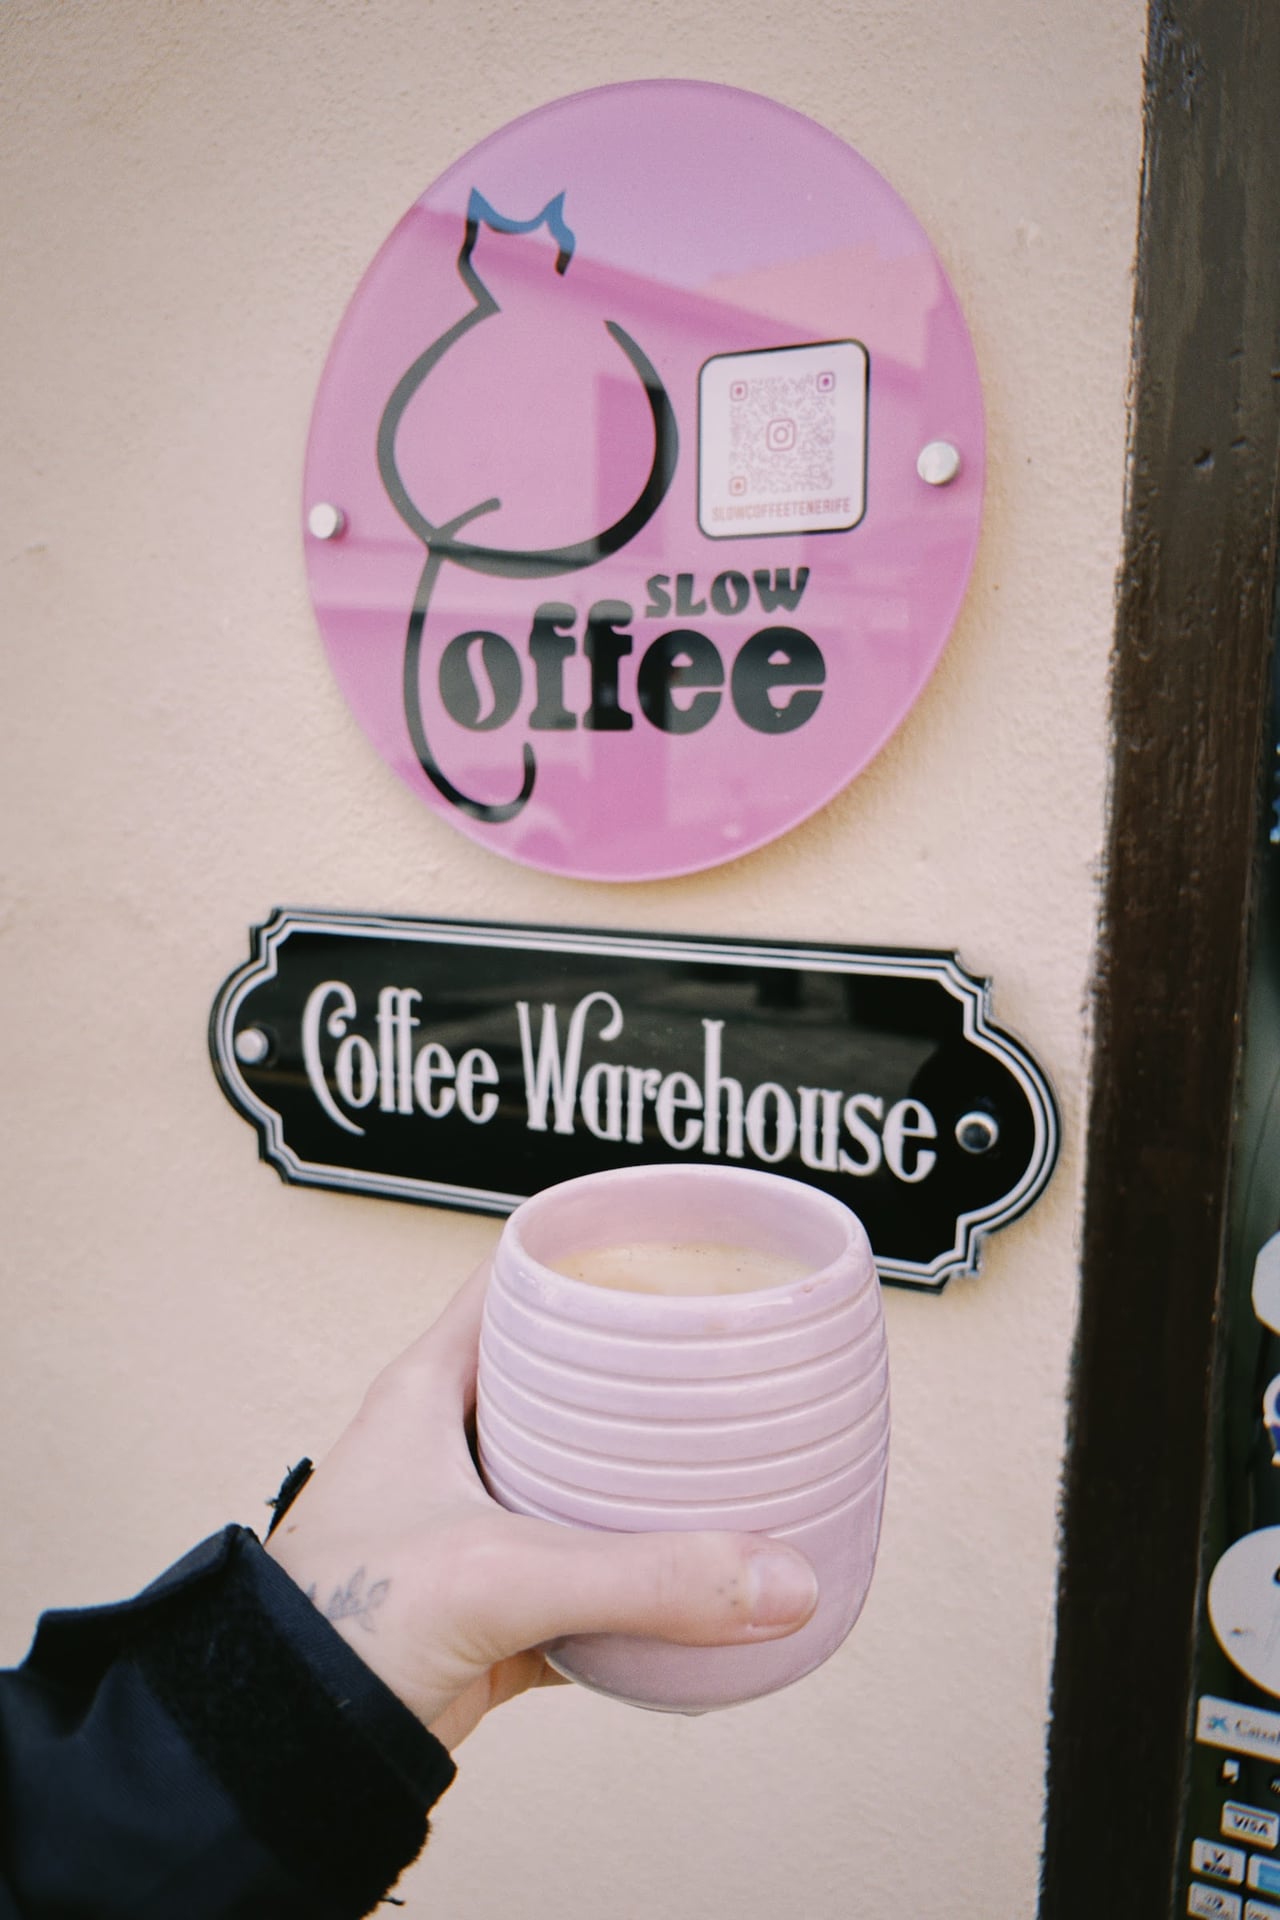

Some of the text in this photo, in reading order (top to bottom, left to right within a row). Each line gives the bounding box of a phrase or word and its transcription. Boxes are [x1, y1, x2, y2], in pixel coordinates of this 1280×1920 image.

[645, 566, 811, 619] SLOW
[301, 980, 938, 1183] Coffee Warehouse
[1235, 1718, 1280, 1744] Caixa
[1233, 1815, 1269, 1835] VISA
